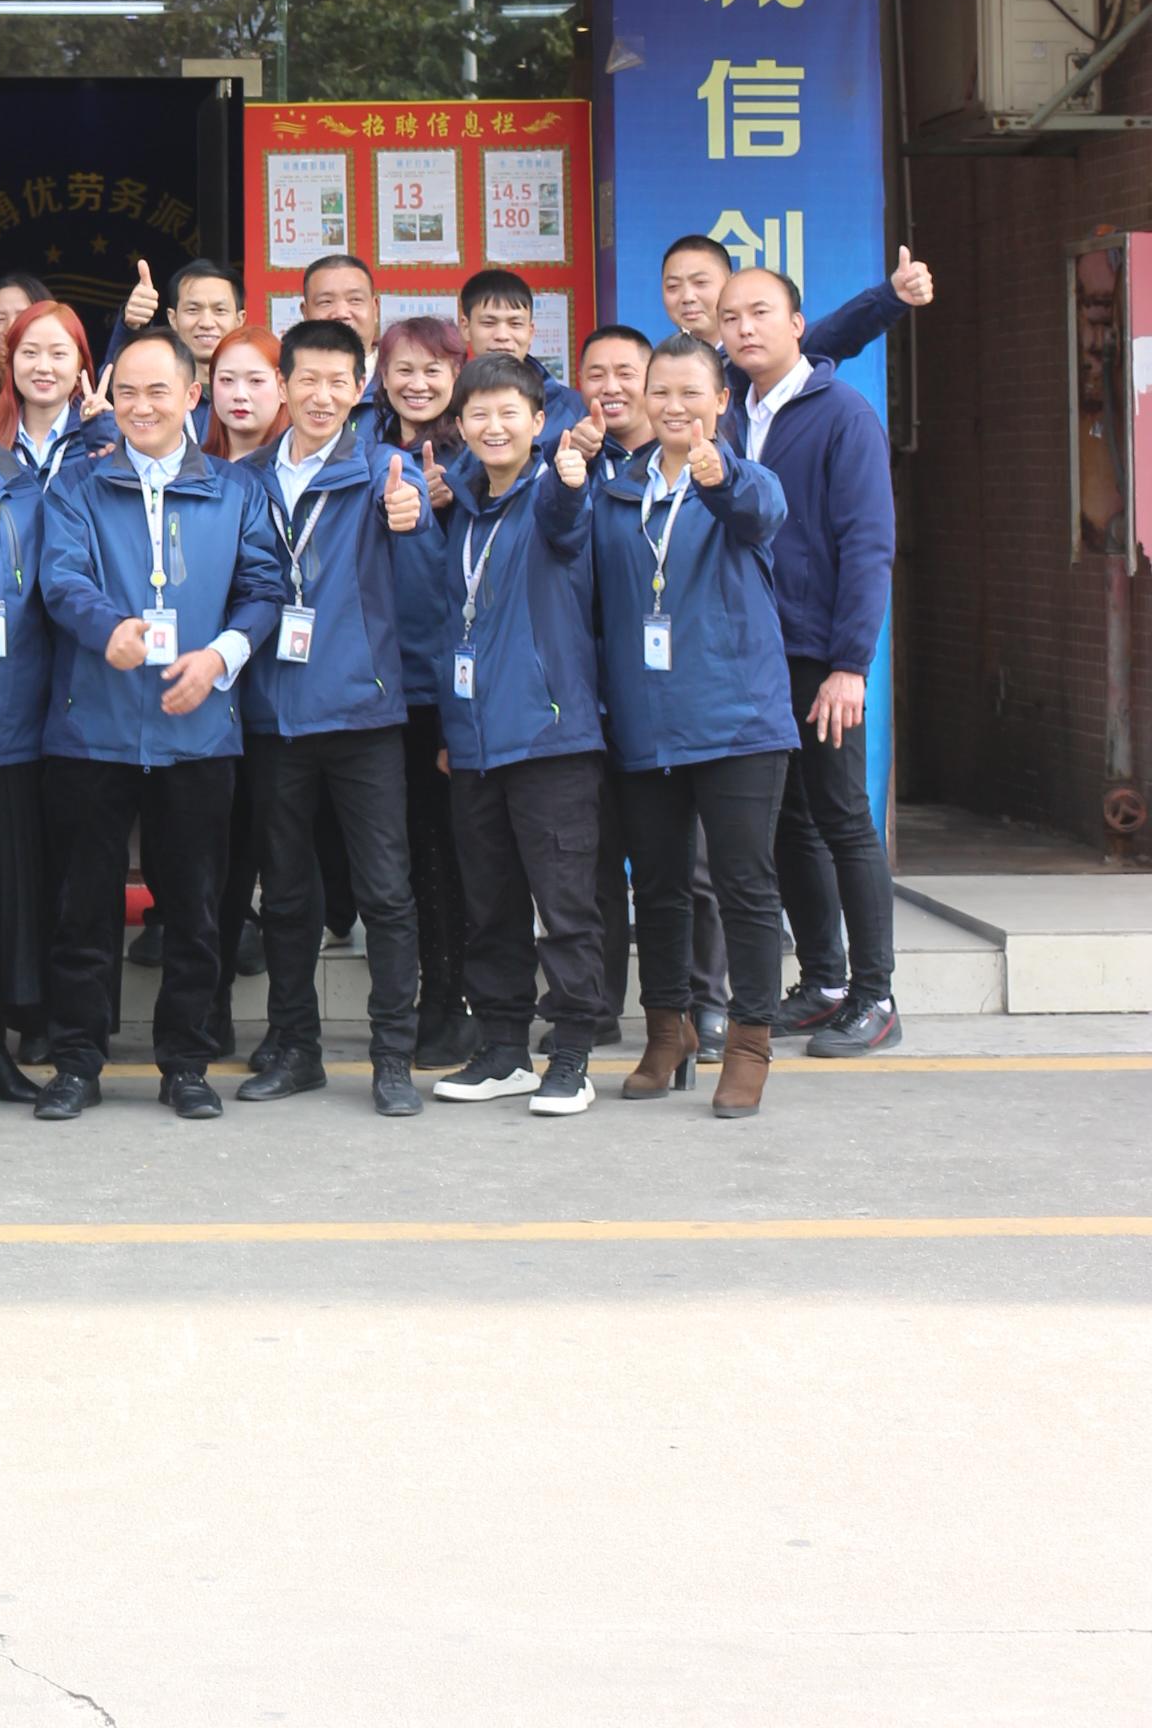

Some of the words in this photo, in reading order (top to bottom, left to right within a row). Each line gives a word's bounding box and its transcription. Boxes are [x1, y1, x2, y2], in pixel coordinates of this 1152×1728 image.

[361, 111, 517, 138] 招聘信息栏
[274, 188, 296, 212] 14
[393, 183, 424, 210] 13
[492, 183, 532, 201] 14.5
[492, 208, 530, 228] 180
[274, 218, 296, 243] 15
